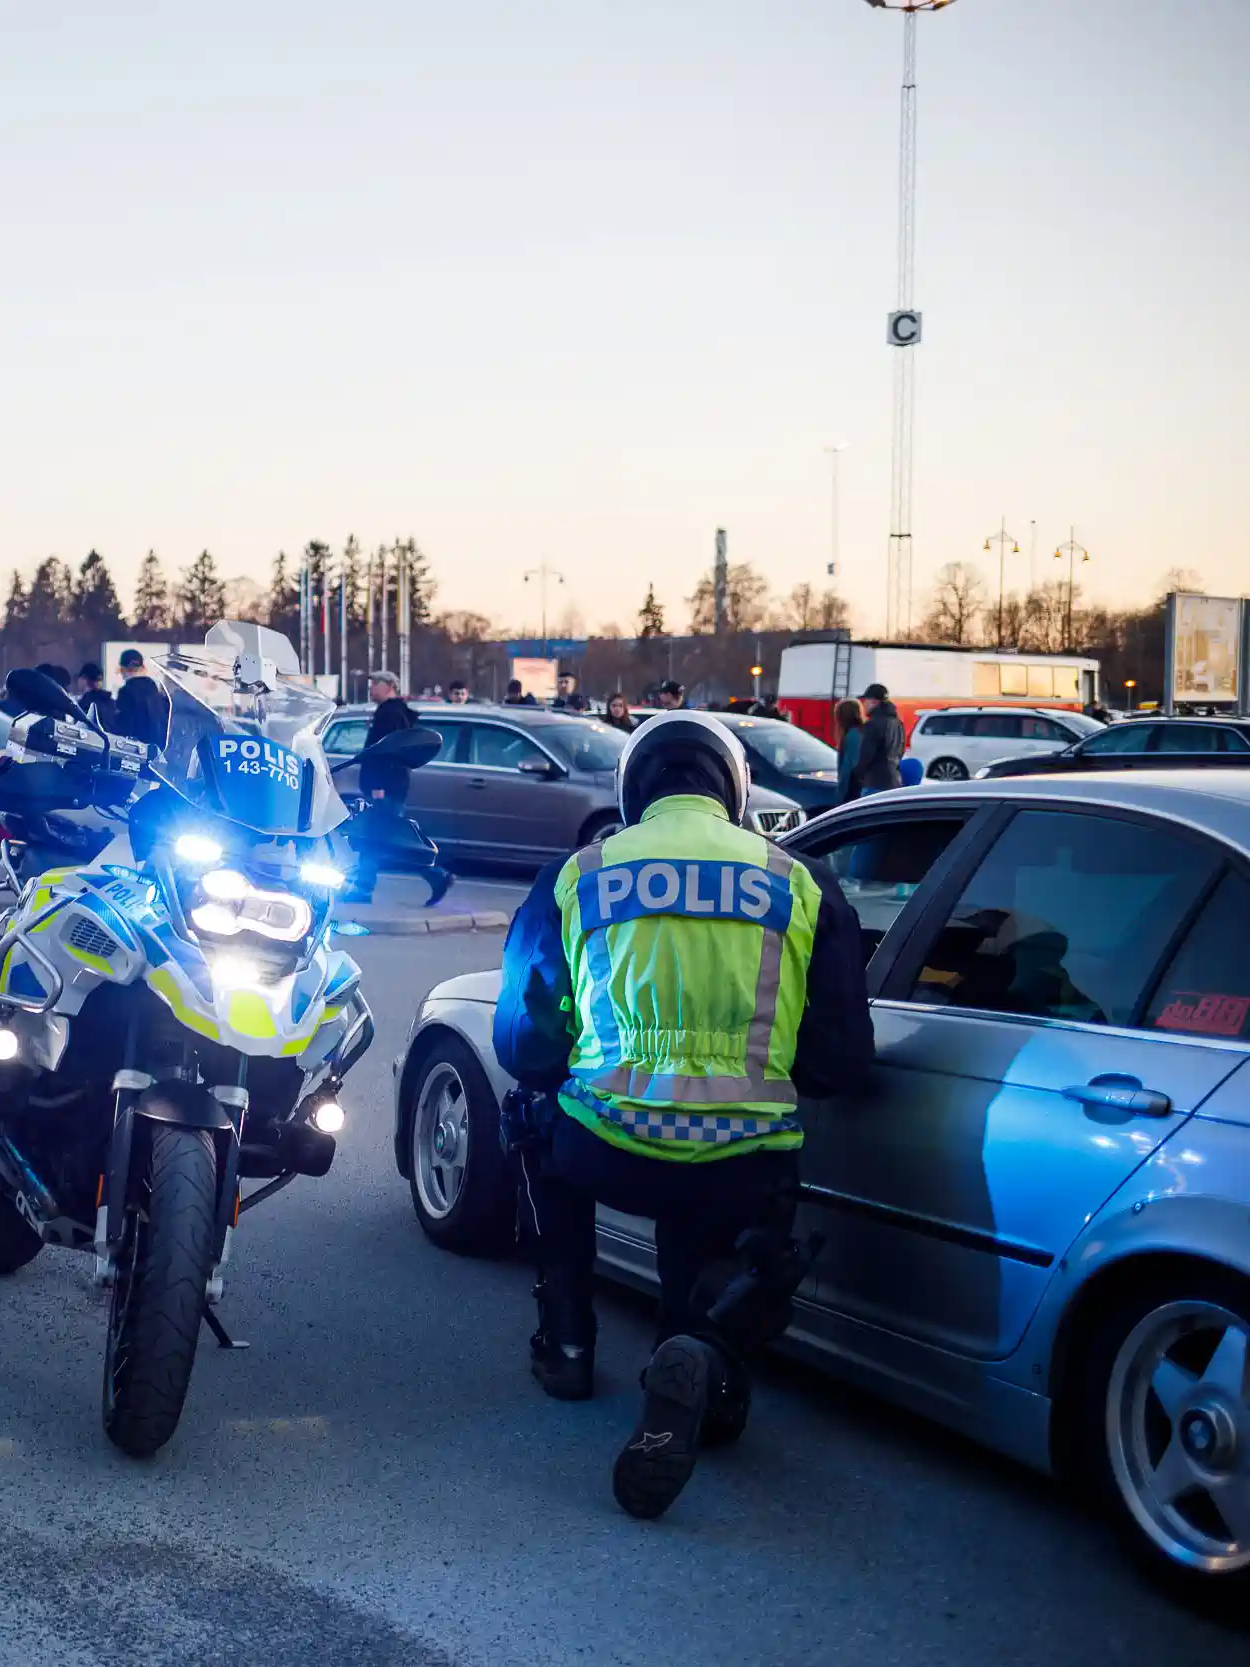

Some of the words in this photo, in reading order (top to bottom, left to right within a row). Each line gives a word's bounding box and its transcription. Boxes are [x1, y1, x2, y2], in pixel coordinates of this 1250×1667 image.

[893, 314, 918, 341] C
[219, 740, 299, 776] POLIS
[223, 760, 231, 773] 1
[238, 760, 299, 790] 43-7710
[597, 862, 772, 920] POLIS
